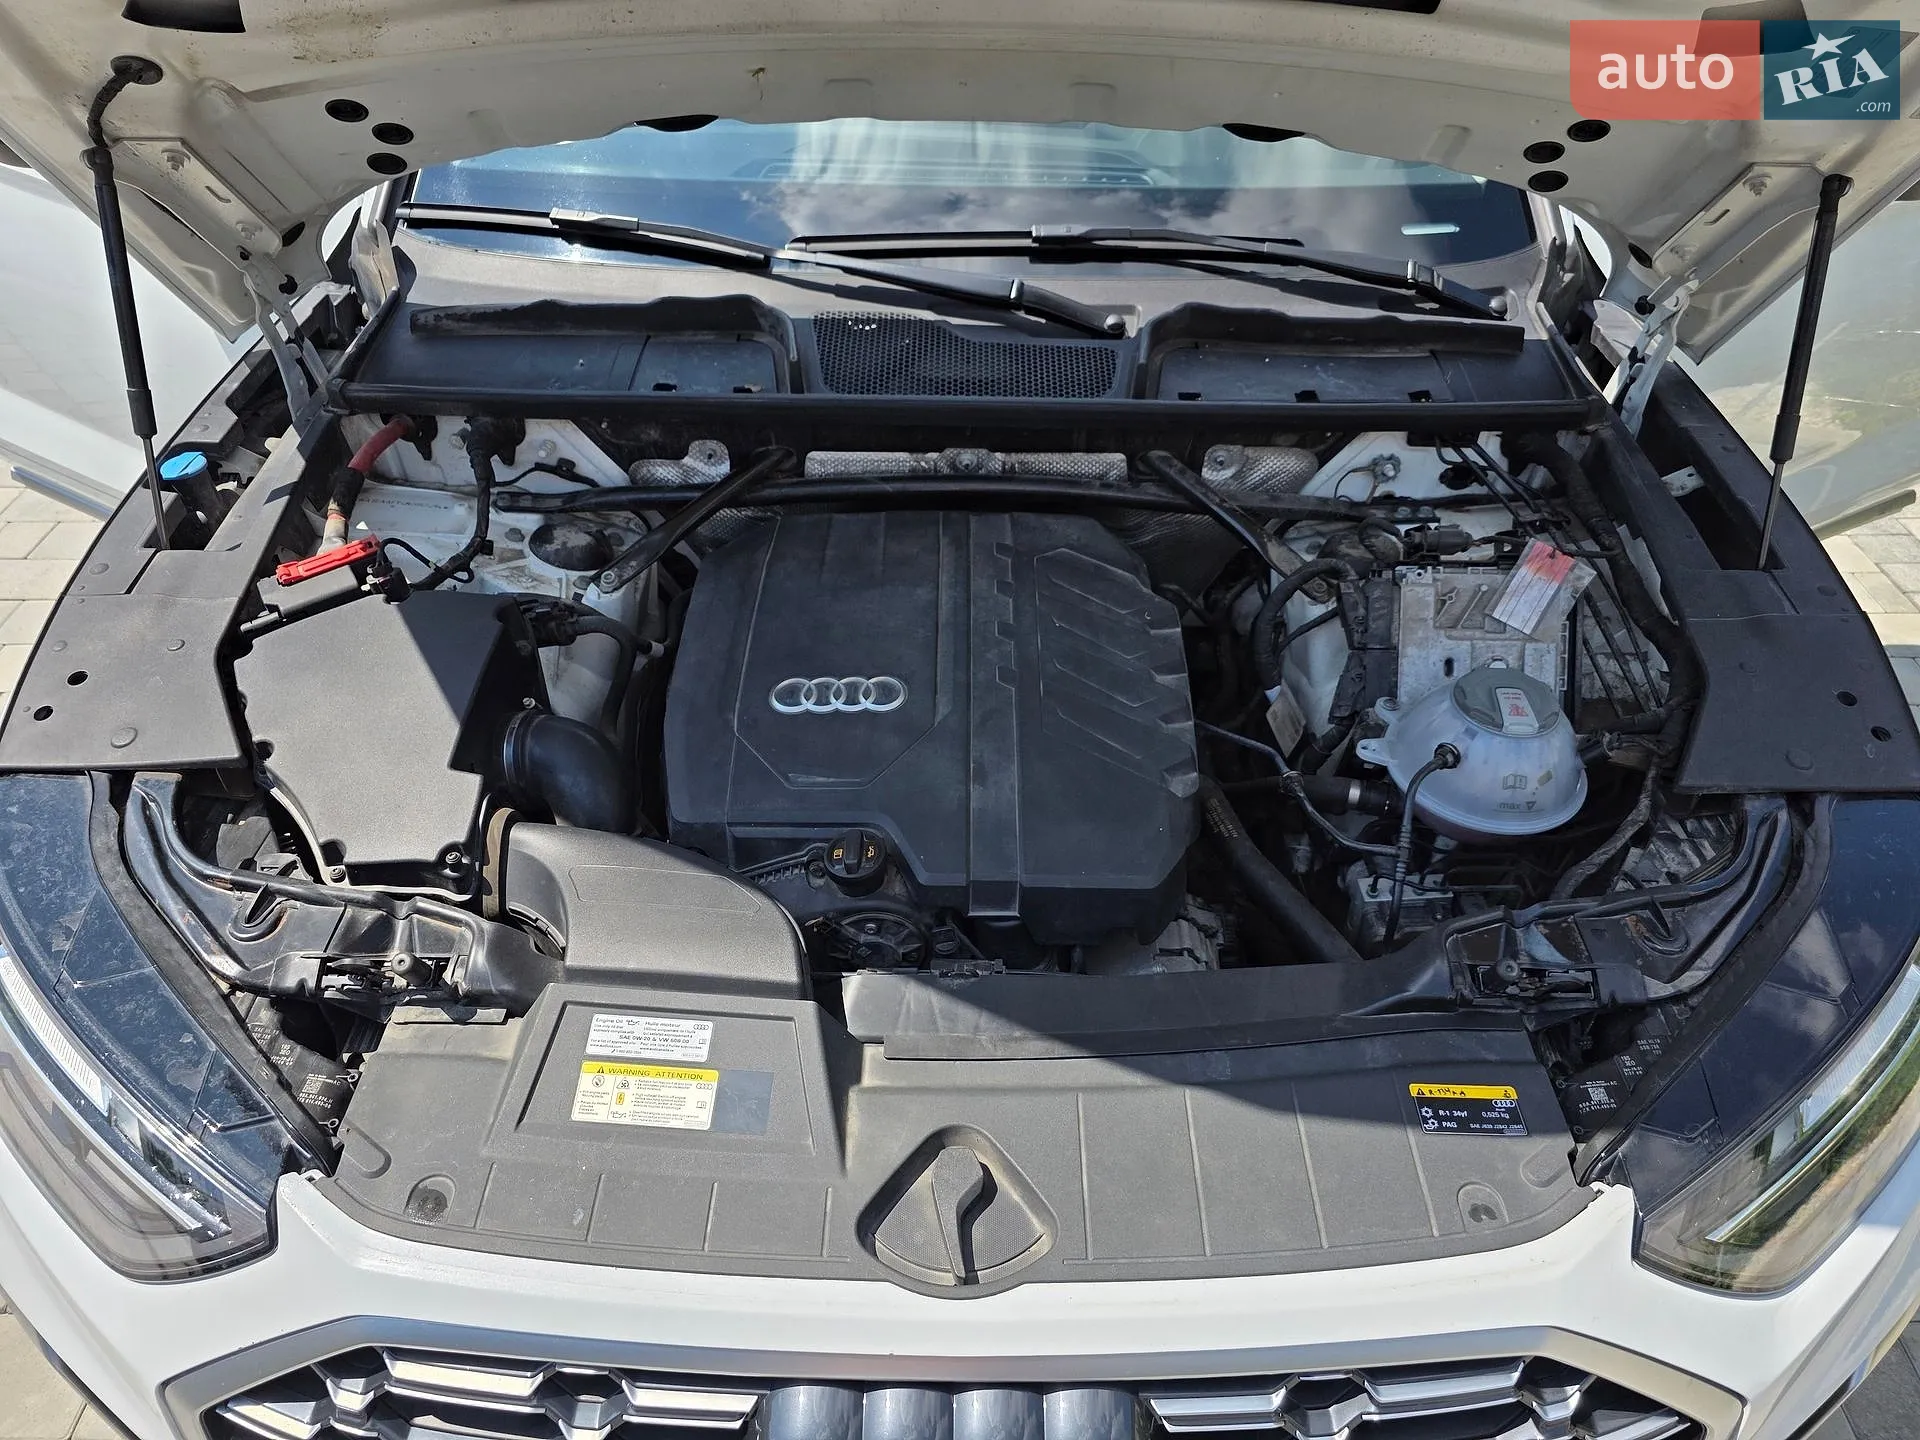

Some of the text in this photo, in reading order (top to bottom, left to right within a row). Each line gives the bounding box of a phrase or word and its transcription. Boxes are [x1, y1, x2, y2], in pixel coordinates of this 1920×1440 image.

[1499, 802, 1521, 810] max
[608, 1067, 704, 1081] WARNING ATTENTION
